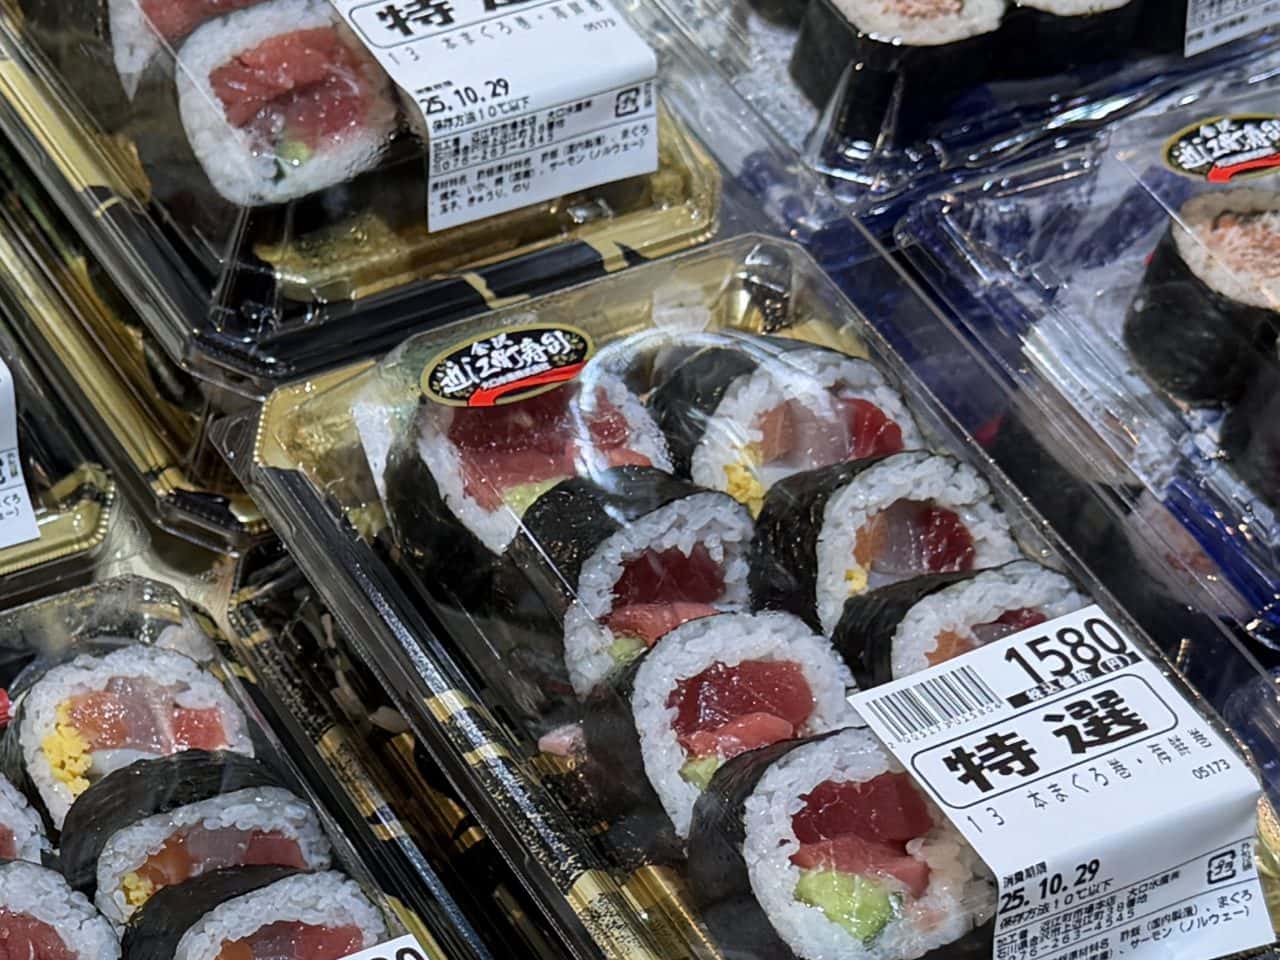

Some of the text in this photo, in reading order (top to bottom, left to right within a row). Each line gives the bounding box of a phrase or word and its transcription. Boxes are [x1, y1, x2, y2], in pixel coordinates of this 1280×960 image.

[1004, 618, 1128, 687] 1580
[942, 689, 1149, 792] 特選
[1192, 758, 1230, 780] 05173
[966, 806, 1005, 833] 13
